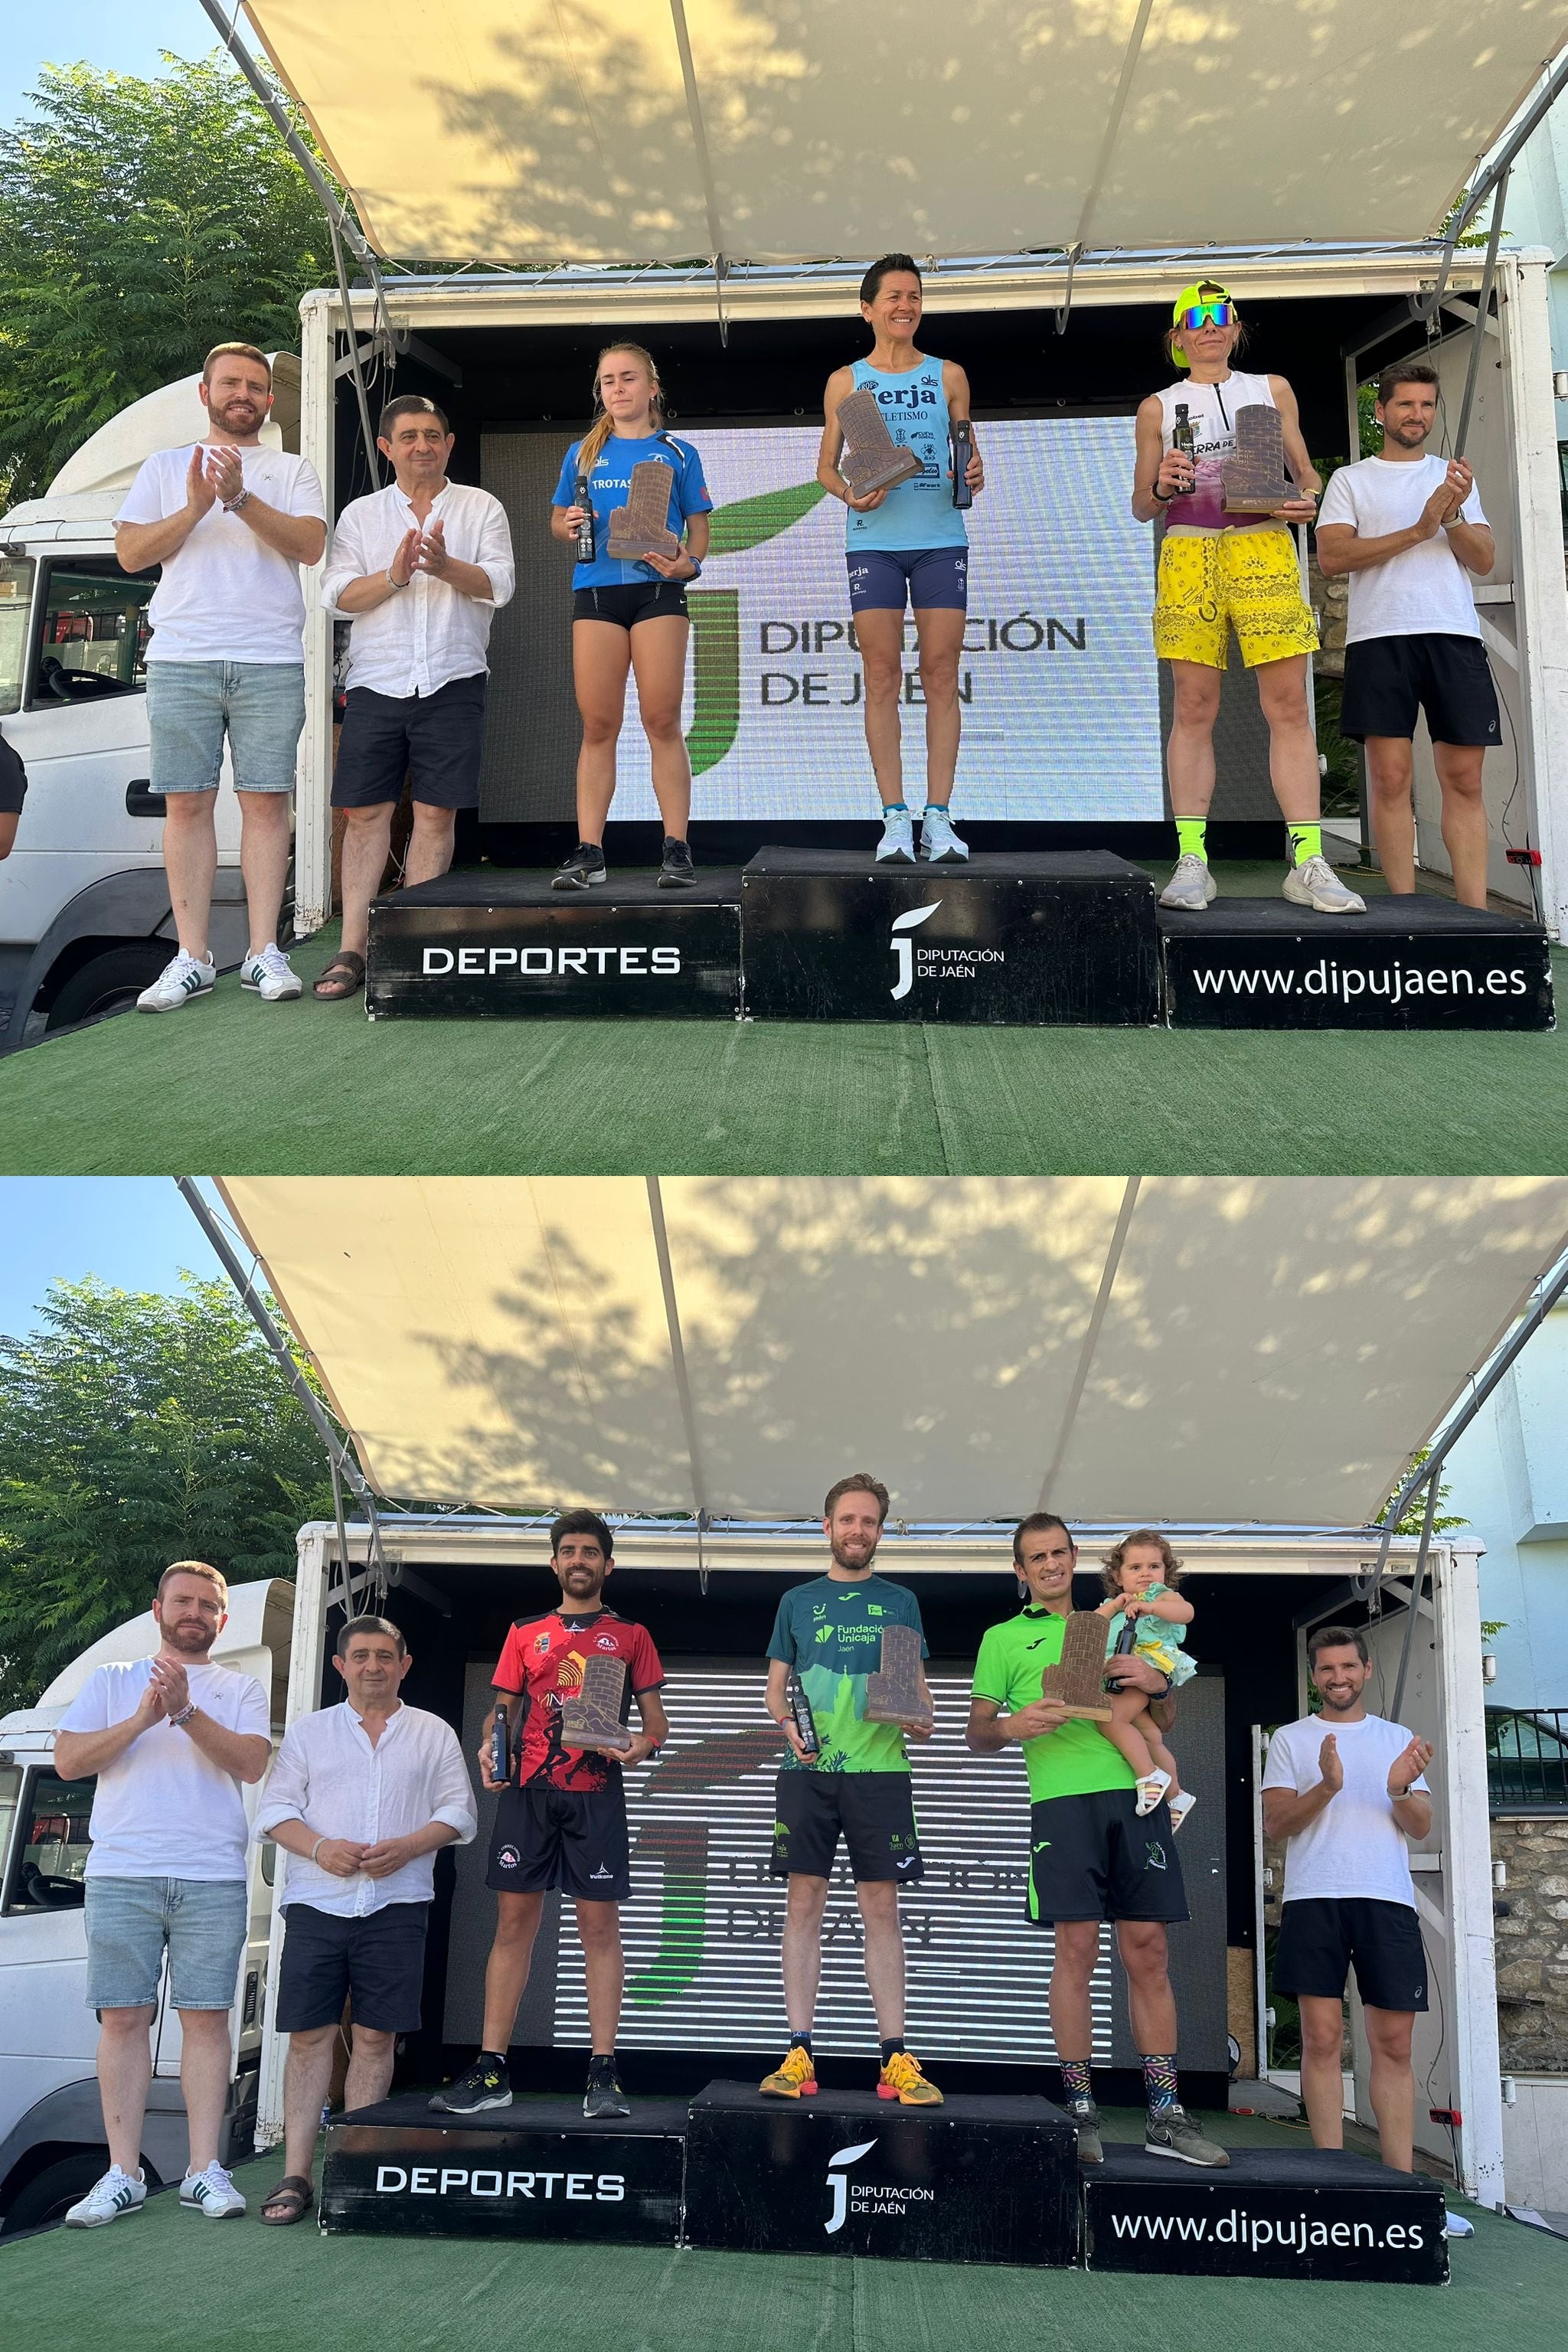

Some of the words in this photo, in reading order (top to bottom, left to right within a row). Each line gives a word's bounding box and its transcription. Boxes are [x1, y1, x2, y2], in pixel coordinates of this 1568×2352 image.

[858, 381, 879, 390] ROPS
[880, 411, 928, 422] LETISMO
[760, 611, 1086, 655] DIPCIÓN
[760, 673, 831, 706] DE
[841, 668, 972, 706] JÉN
[423, 947, 681, 975] DEPORTES
[917, 949, 1004, 962] DIPUTACIÓN
[917, 965, 937, 977] DE
[939, 964, 975, 978] JAÉN
[1193, 959, 1527, 1004] www.dipujaen.es
[838, 1625, 884, 1634] Fundació
[838, 1633, 876, 1644] Unicaja
[376, 2166, 626, 2201] DEPORTES
[851, 2185, 934, 2200] DIPUTACIÓN
[851, 2201, 870, 2213] DE
[871, 2201, 906, 2215] JAÉN
[1112, 2209, 1424, 2254] www.dipujaen.es
